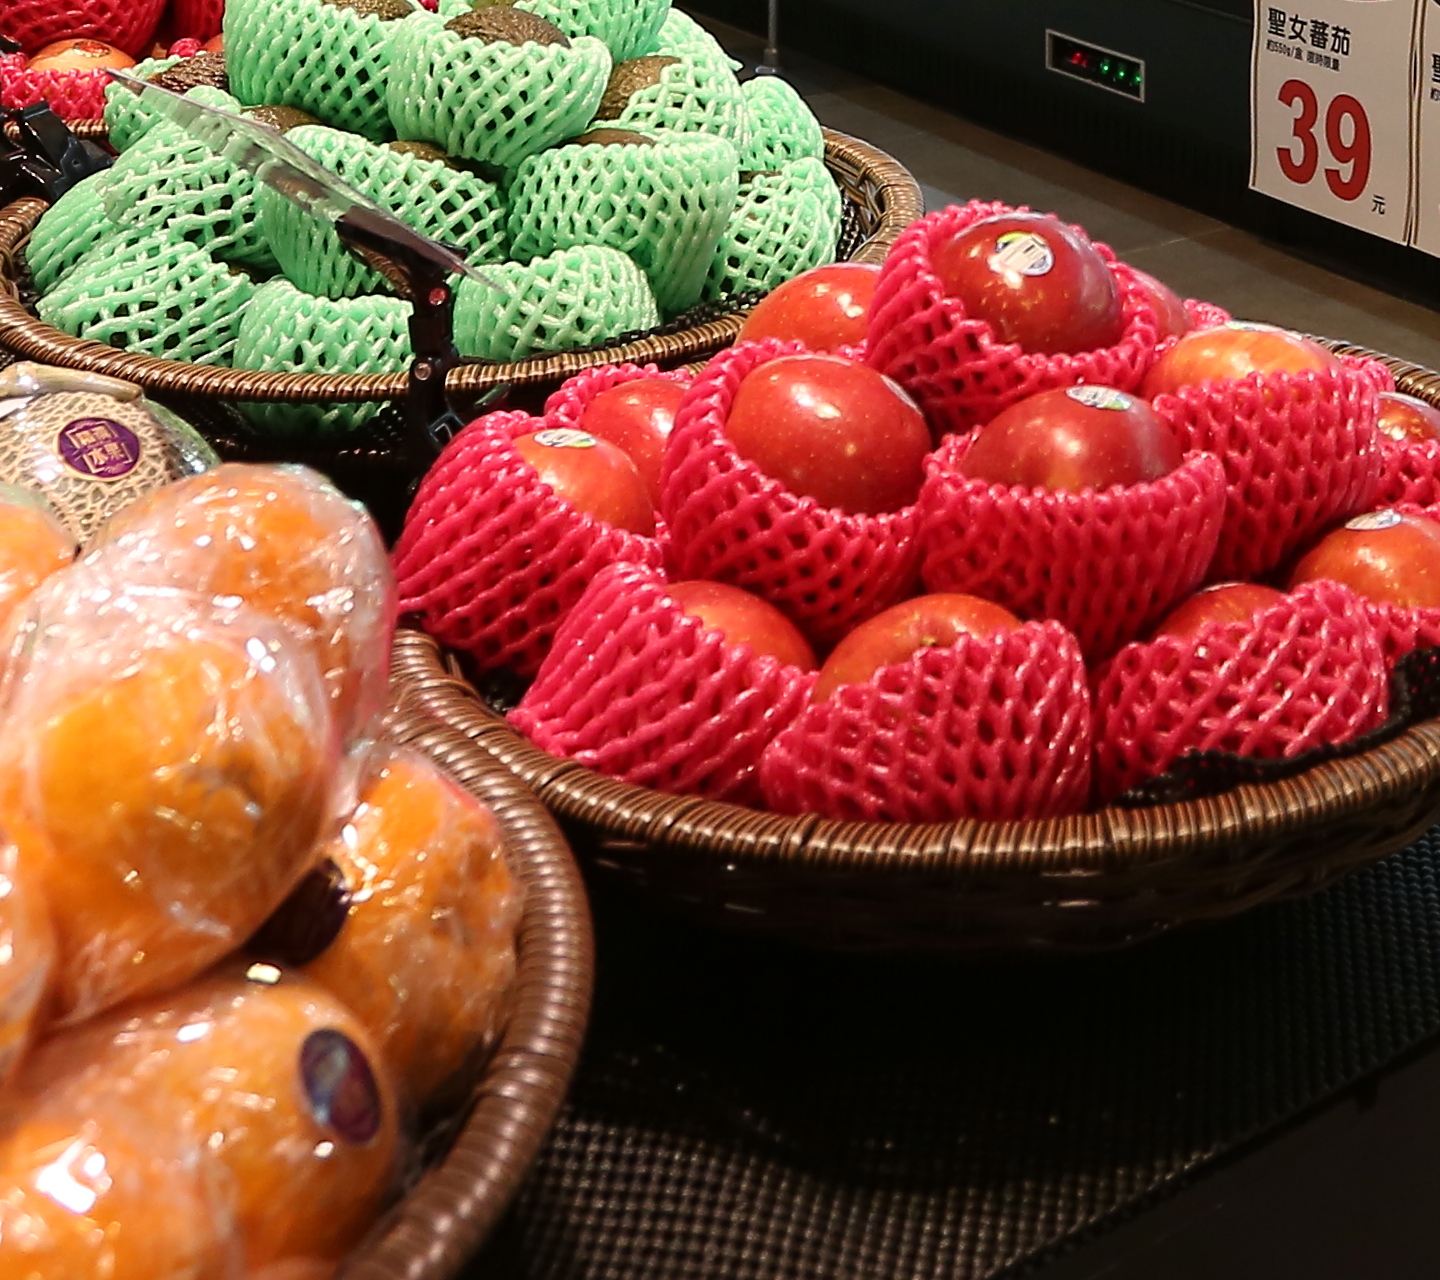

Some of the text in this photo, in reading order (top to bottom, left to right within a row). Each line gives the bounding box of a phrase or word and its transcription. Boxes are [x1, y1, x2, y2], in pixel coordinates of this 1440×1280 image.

[1267, 6, 1351, 57] 聖女蕃茄
[1276, 79, 1387, 216] 39 元
[87, 442, 126, 469] 水果
